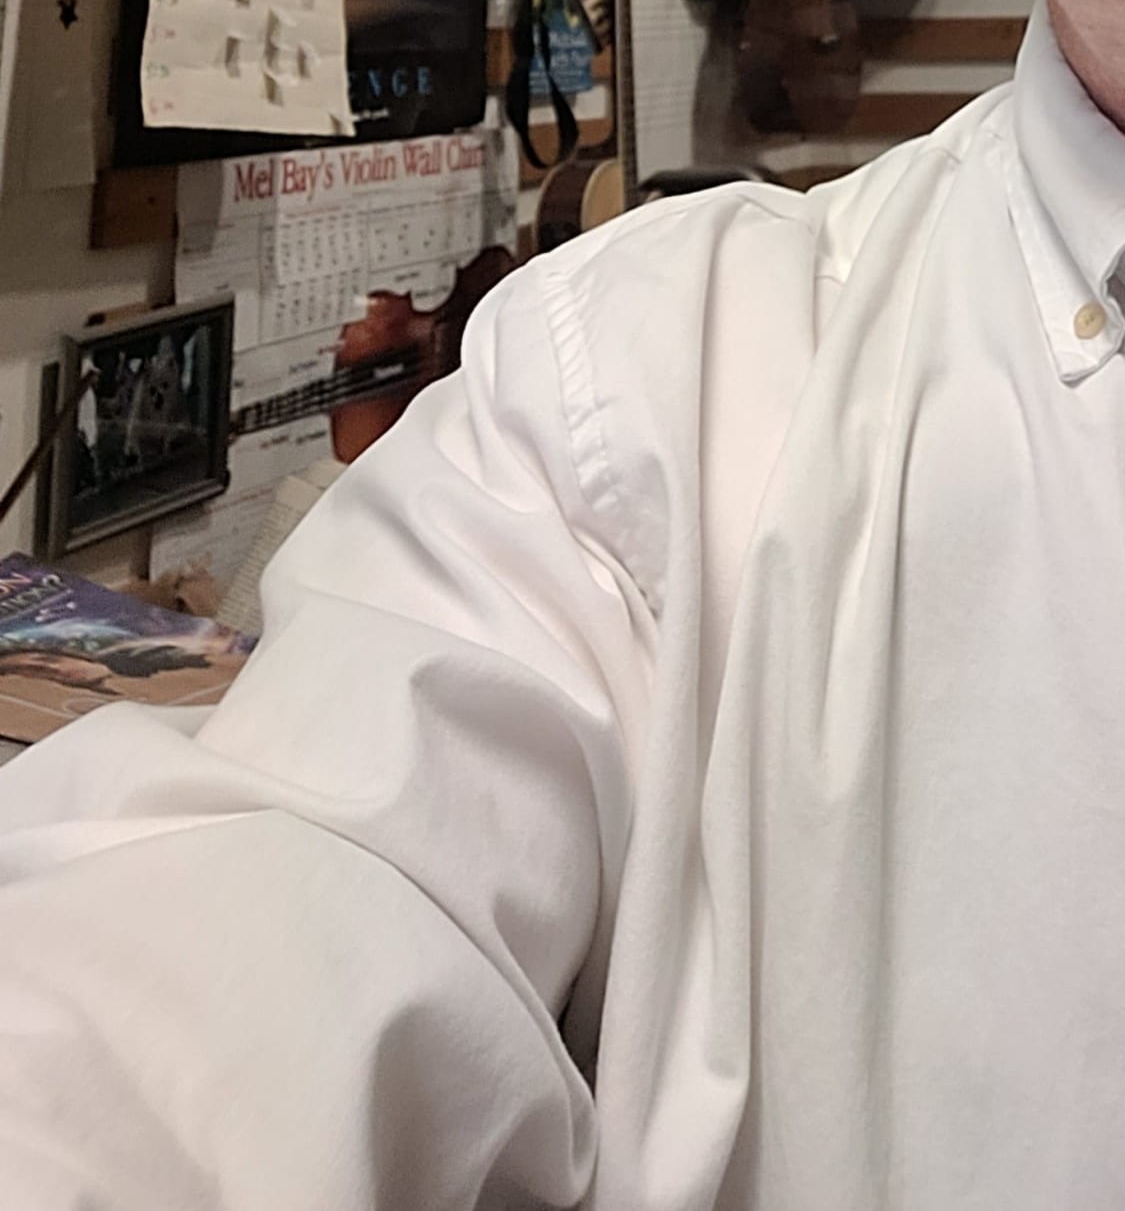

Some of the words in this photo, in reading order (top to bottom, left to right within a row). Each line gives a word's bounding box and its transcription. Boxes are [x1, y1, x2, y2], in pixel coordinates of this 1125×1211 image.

[233, 159, 274, 202] Mel
[281, 151, 334, 200] Bay's
[340, 145, 397, 185] Violin
[402, 142, 442, 177] Wall
